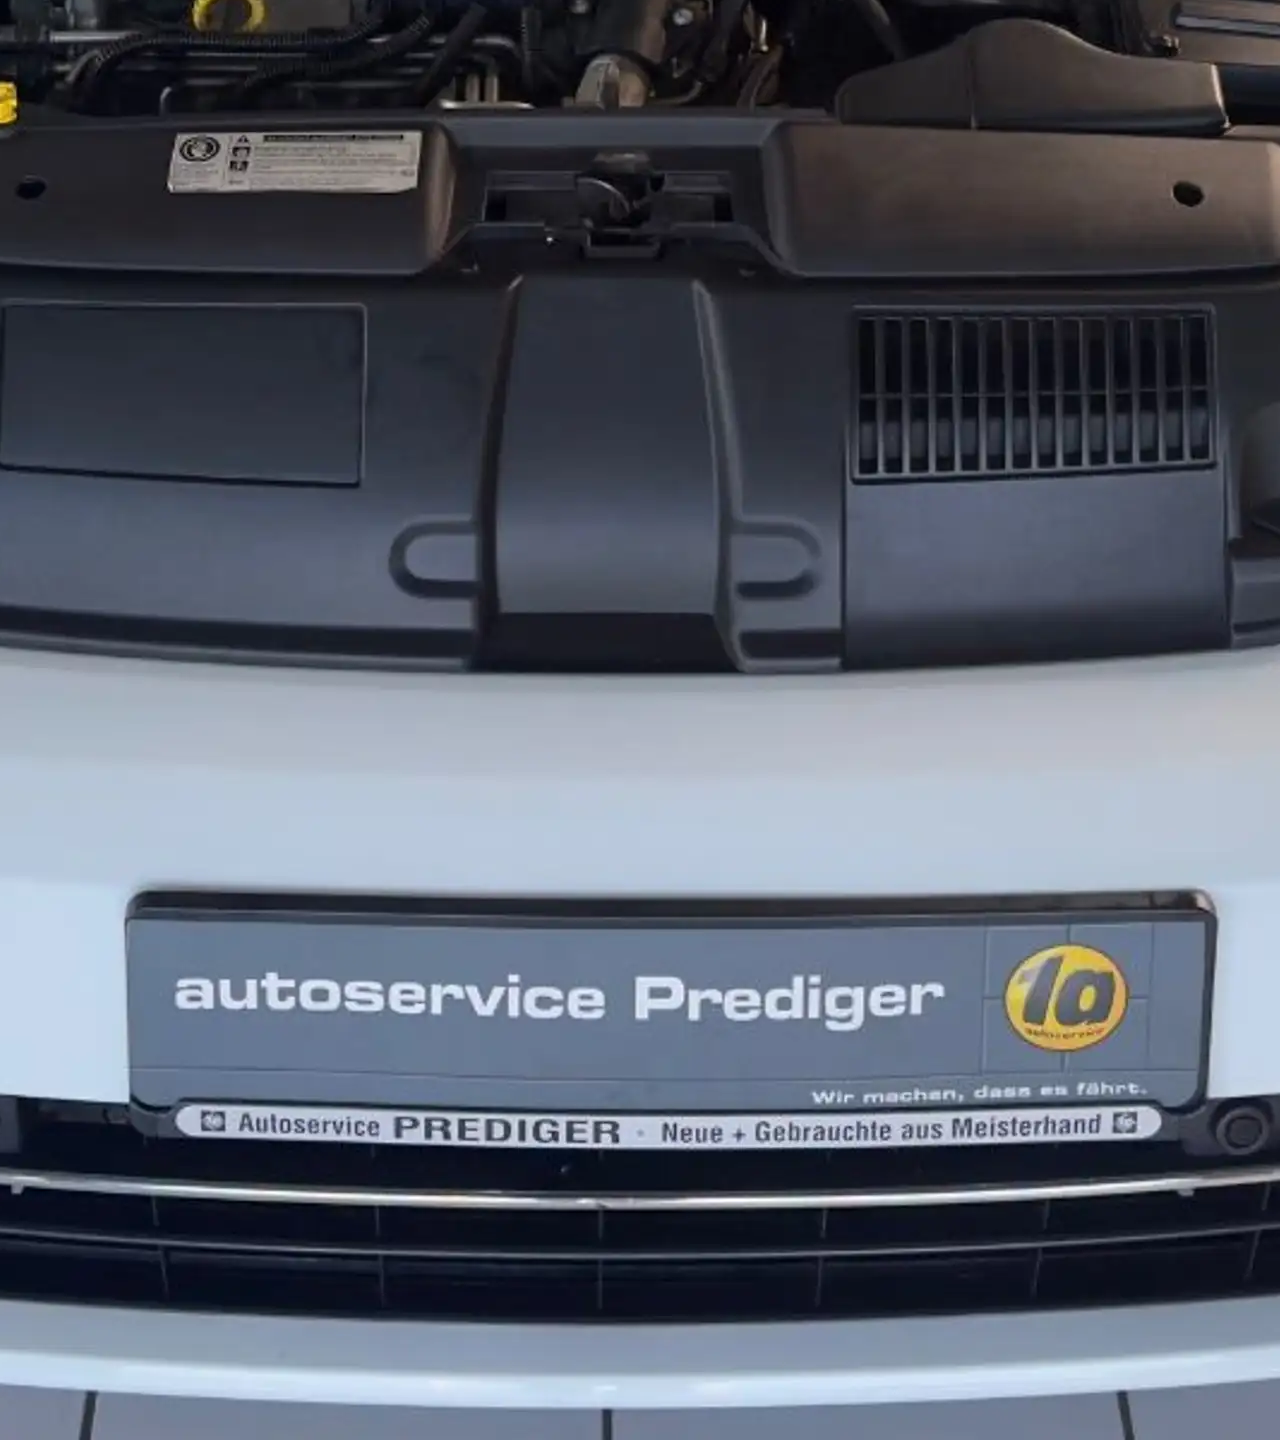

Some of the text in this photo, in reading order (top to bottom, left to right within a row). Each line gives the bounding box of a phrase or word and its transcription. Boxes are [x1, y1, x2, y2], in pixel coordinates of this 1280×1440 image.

[174, 971, 946, 1032] autoservice Prediger
[811, 1091, 854, 1105] Wir
[862, 1088, 965, 1104] machen,
[973, 1085, 1032, 1099] dass
[1076, 1081, 1149, 1096] fährt.
[238, 1112, 1103, 1145] Autoservice PREDIGER Neue + Gebrauchte aus Meisterhand
